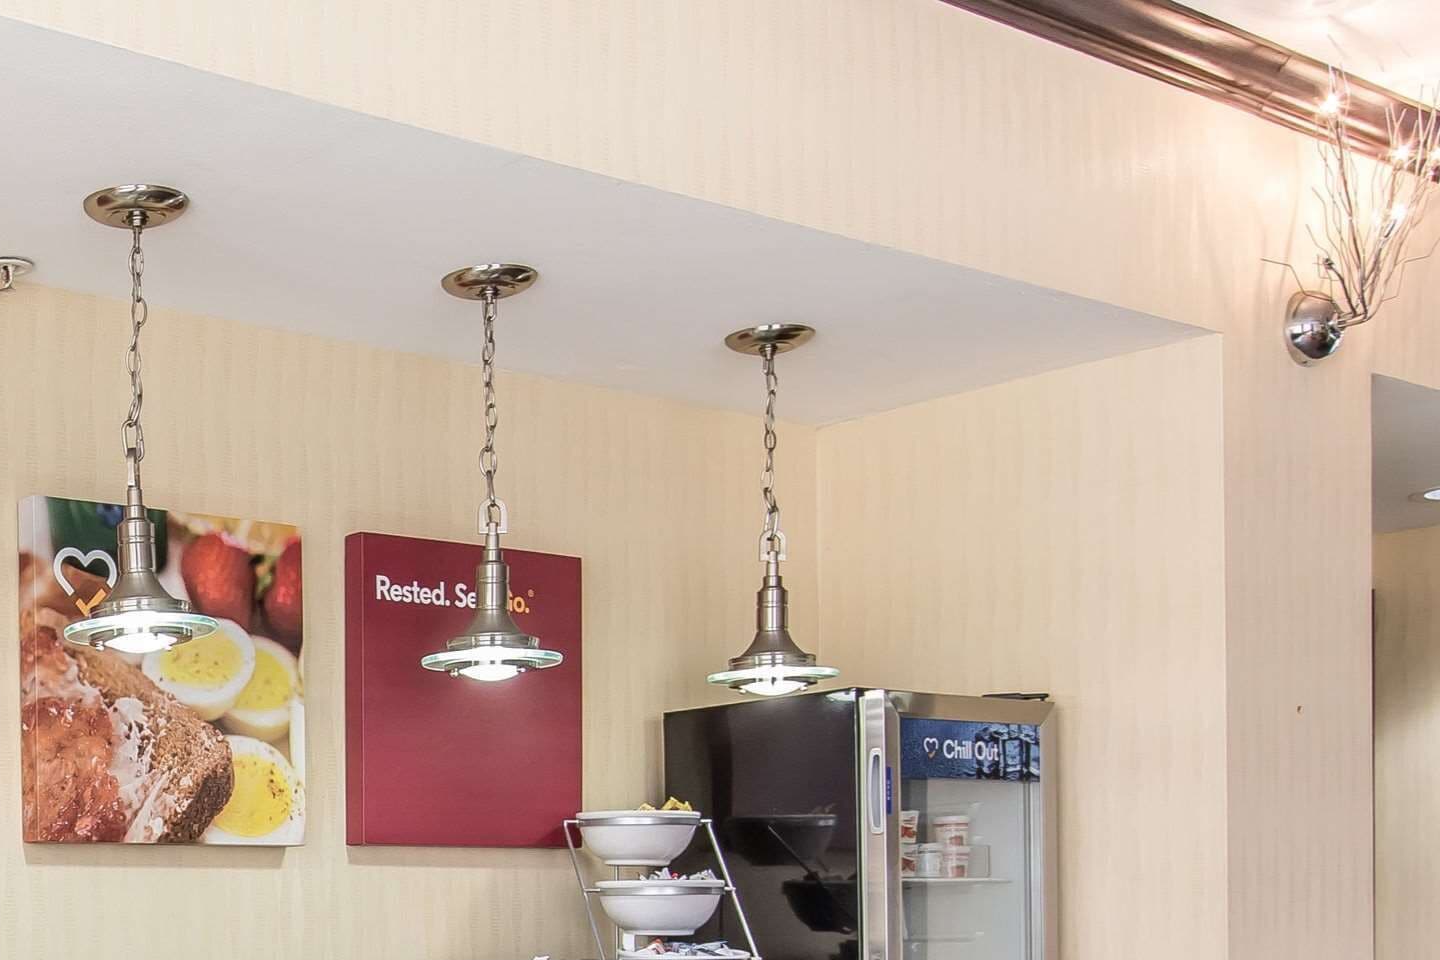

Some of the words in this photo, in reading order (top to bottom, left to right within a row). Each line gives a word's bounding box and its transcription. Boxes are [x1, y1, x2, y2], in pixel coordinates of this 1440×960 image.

[375, 574, 450, 608] Rested.
[508, 590, 531, 614] o.
[942, 738, 973, 761] Chill
[974, 740, 1000, 762] Out
